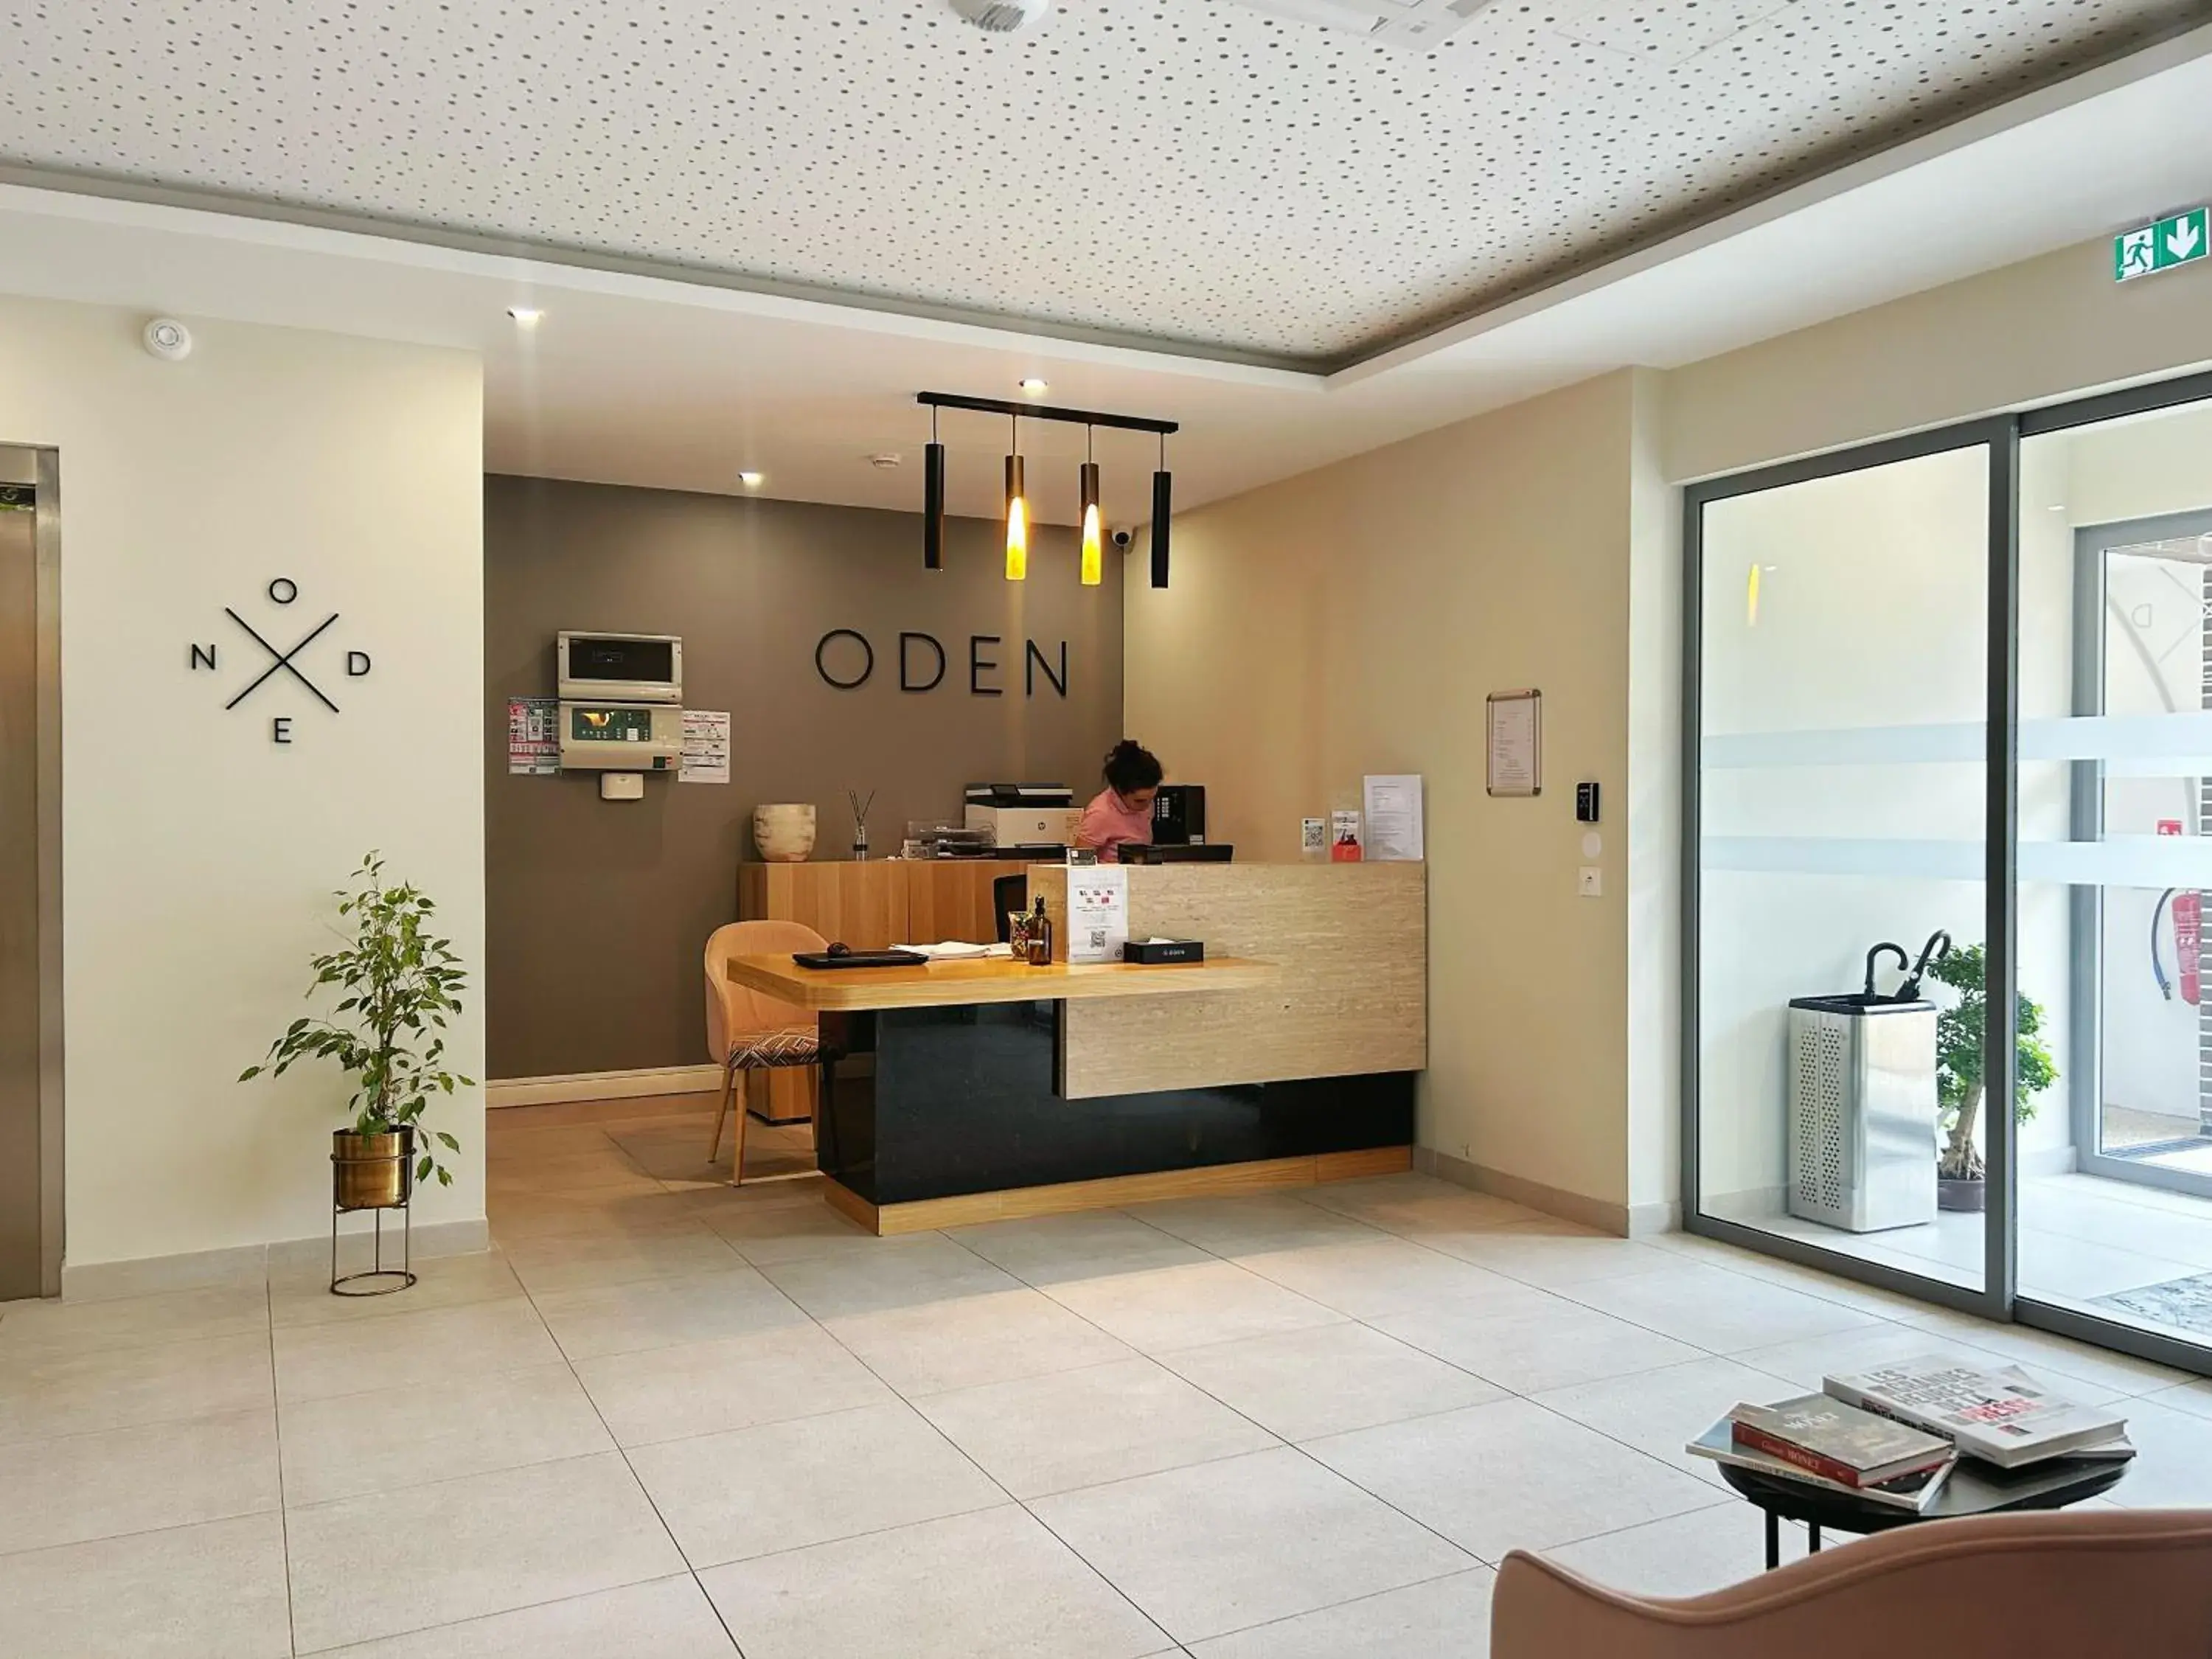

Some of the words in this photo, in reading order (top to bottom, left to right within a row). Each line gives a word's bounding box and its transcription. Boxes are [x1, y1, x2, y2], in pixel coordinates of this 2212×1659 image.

[268, 577, 297, 604] O
[191, 644, 216, 670] N
[348, 651, 371, 676] D
[815, 628, 1067, 698] ODEN
[274, 717, 292, 743] E
